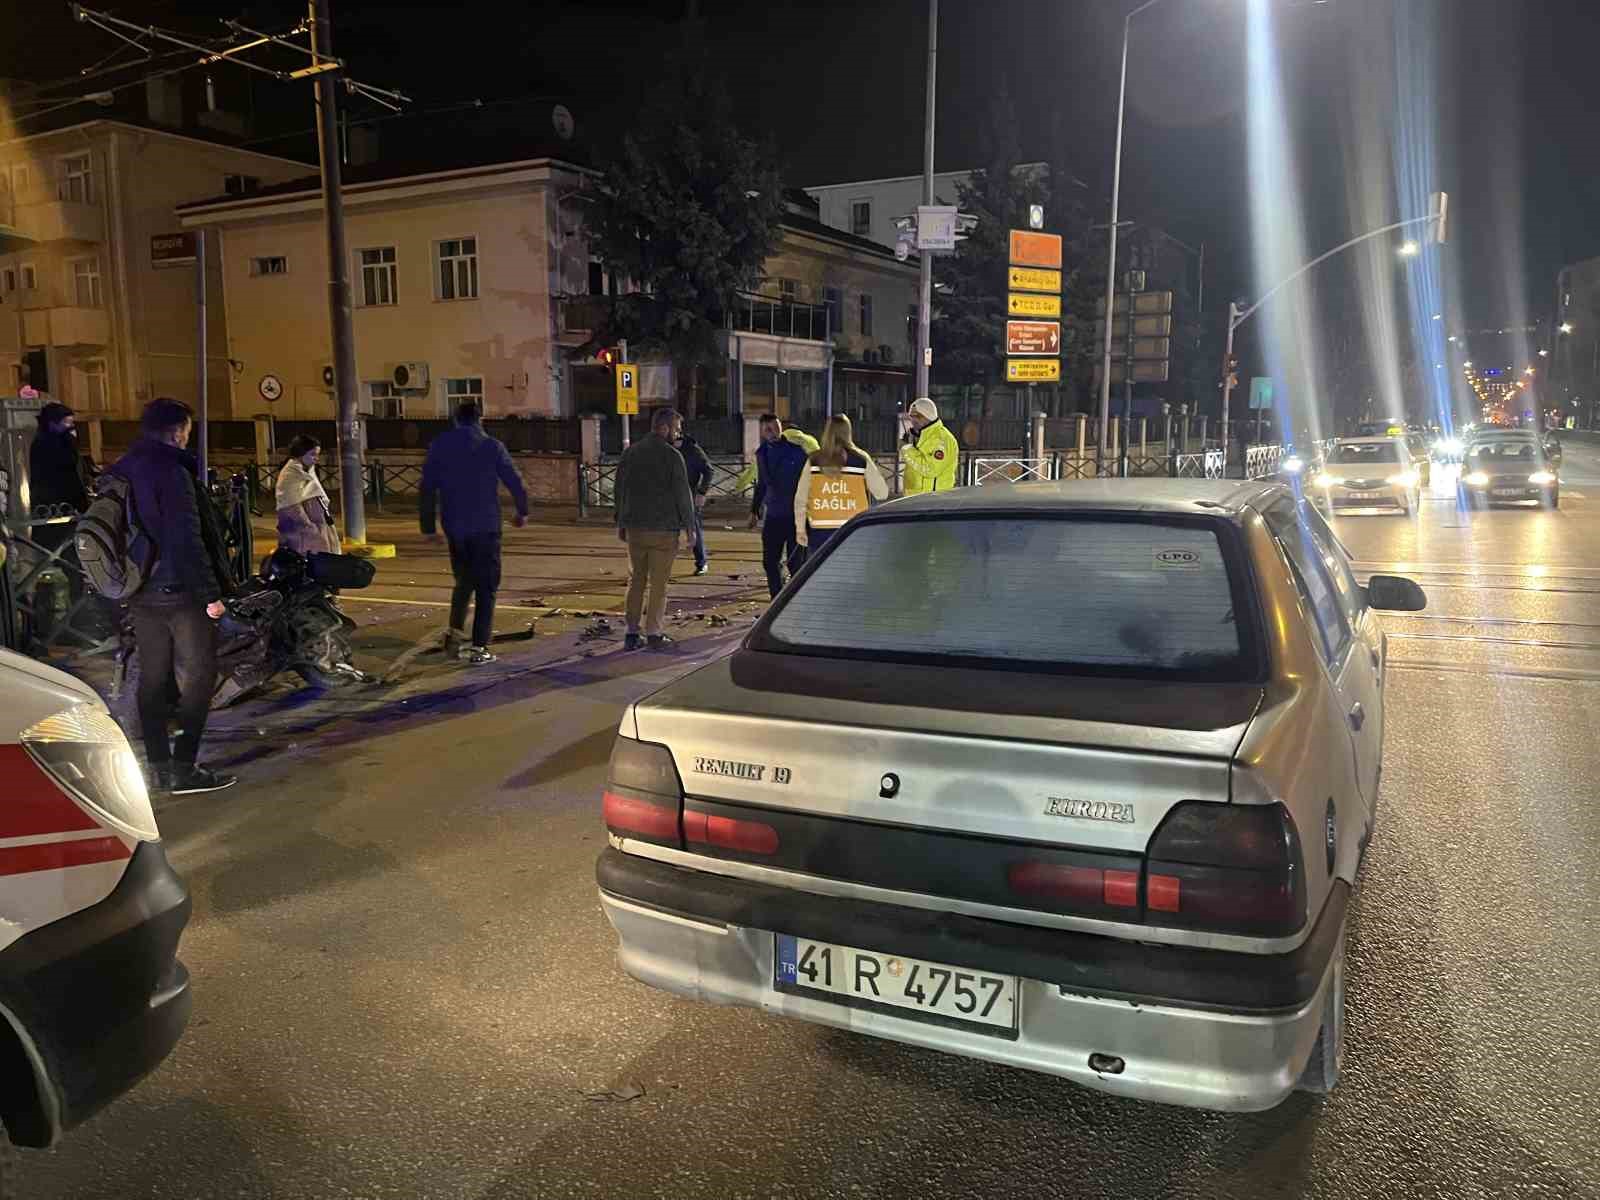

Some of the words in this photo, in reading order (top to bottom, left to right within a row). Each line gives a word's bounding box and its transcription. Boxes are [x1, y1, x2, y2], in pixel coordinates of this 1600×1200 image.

[623, 372, 631, 388] P
[822, 479, 850, 494] ACİL
[813, 495, 857, 510] SAĞLIK
[693, 756, 764, 781] RENAULT
[771, 767, 792, 785] 19
[1044, 796, 1136, 823] EUROPA
[780, 961, 796, 973] TR
[797, 944, 832, 986] 41
[854, 954, 881, 996] R
[904, 964, 1004, 1017] 4757
